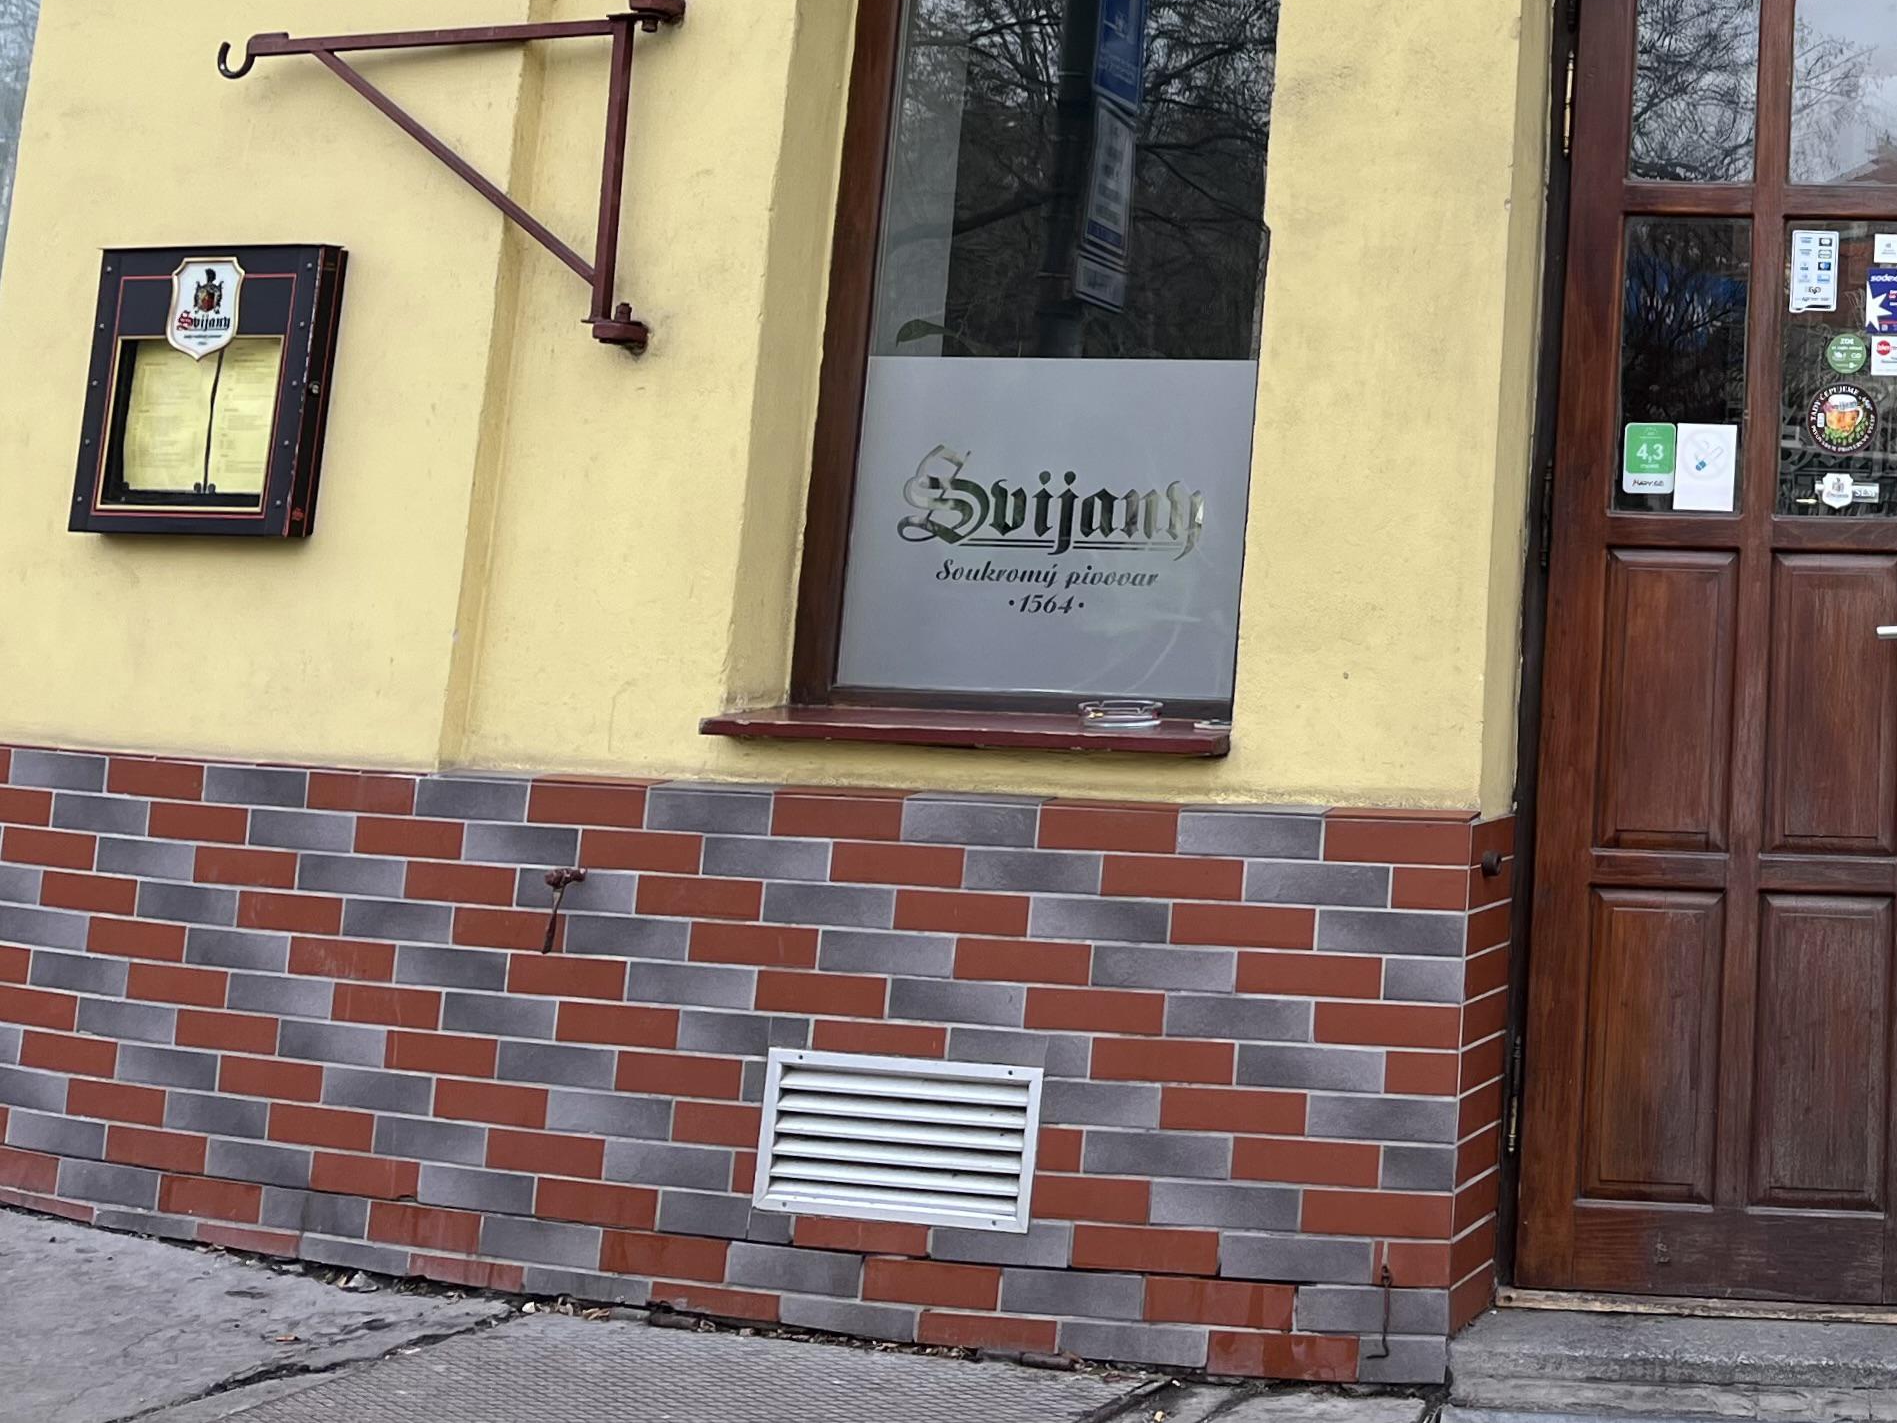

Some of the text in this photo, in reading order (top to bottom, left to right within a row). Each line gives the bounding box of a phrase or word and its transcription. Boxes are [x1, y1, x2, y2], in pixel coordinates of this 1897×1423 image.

[176, 310, 231, 332] Svijany
[1636, 443, 1664, 464] 4,3
[897, 444, 1206, 561] Svijany
[935, 559, 1159, 589] Soukromý pivovar
